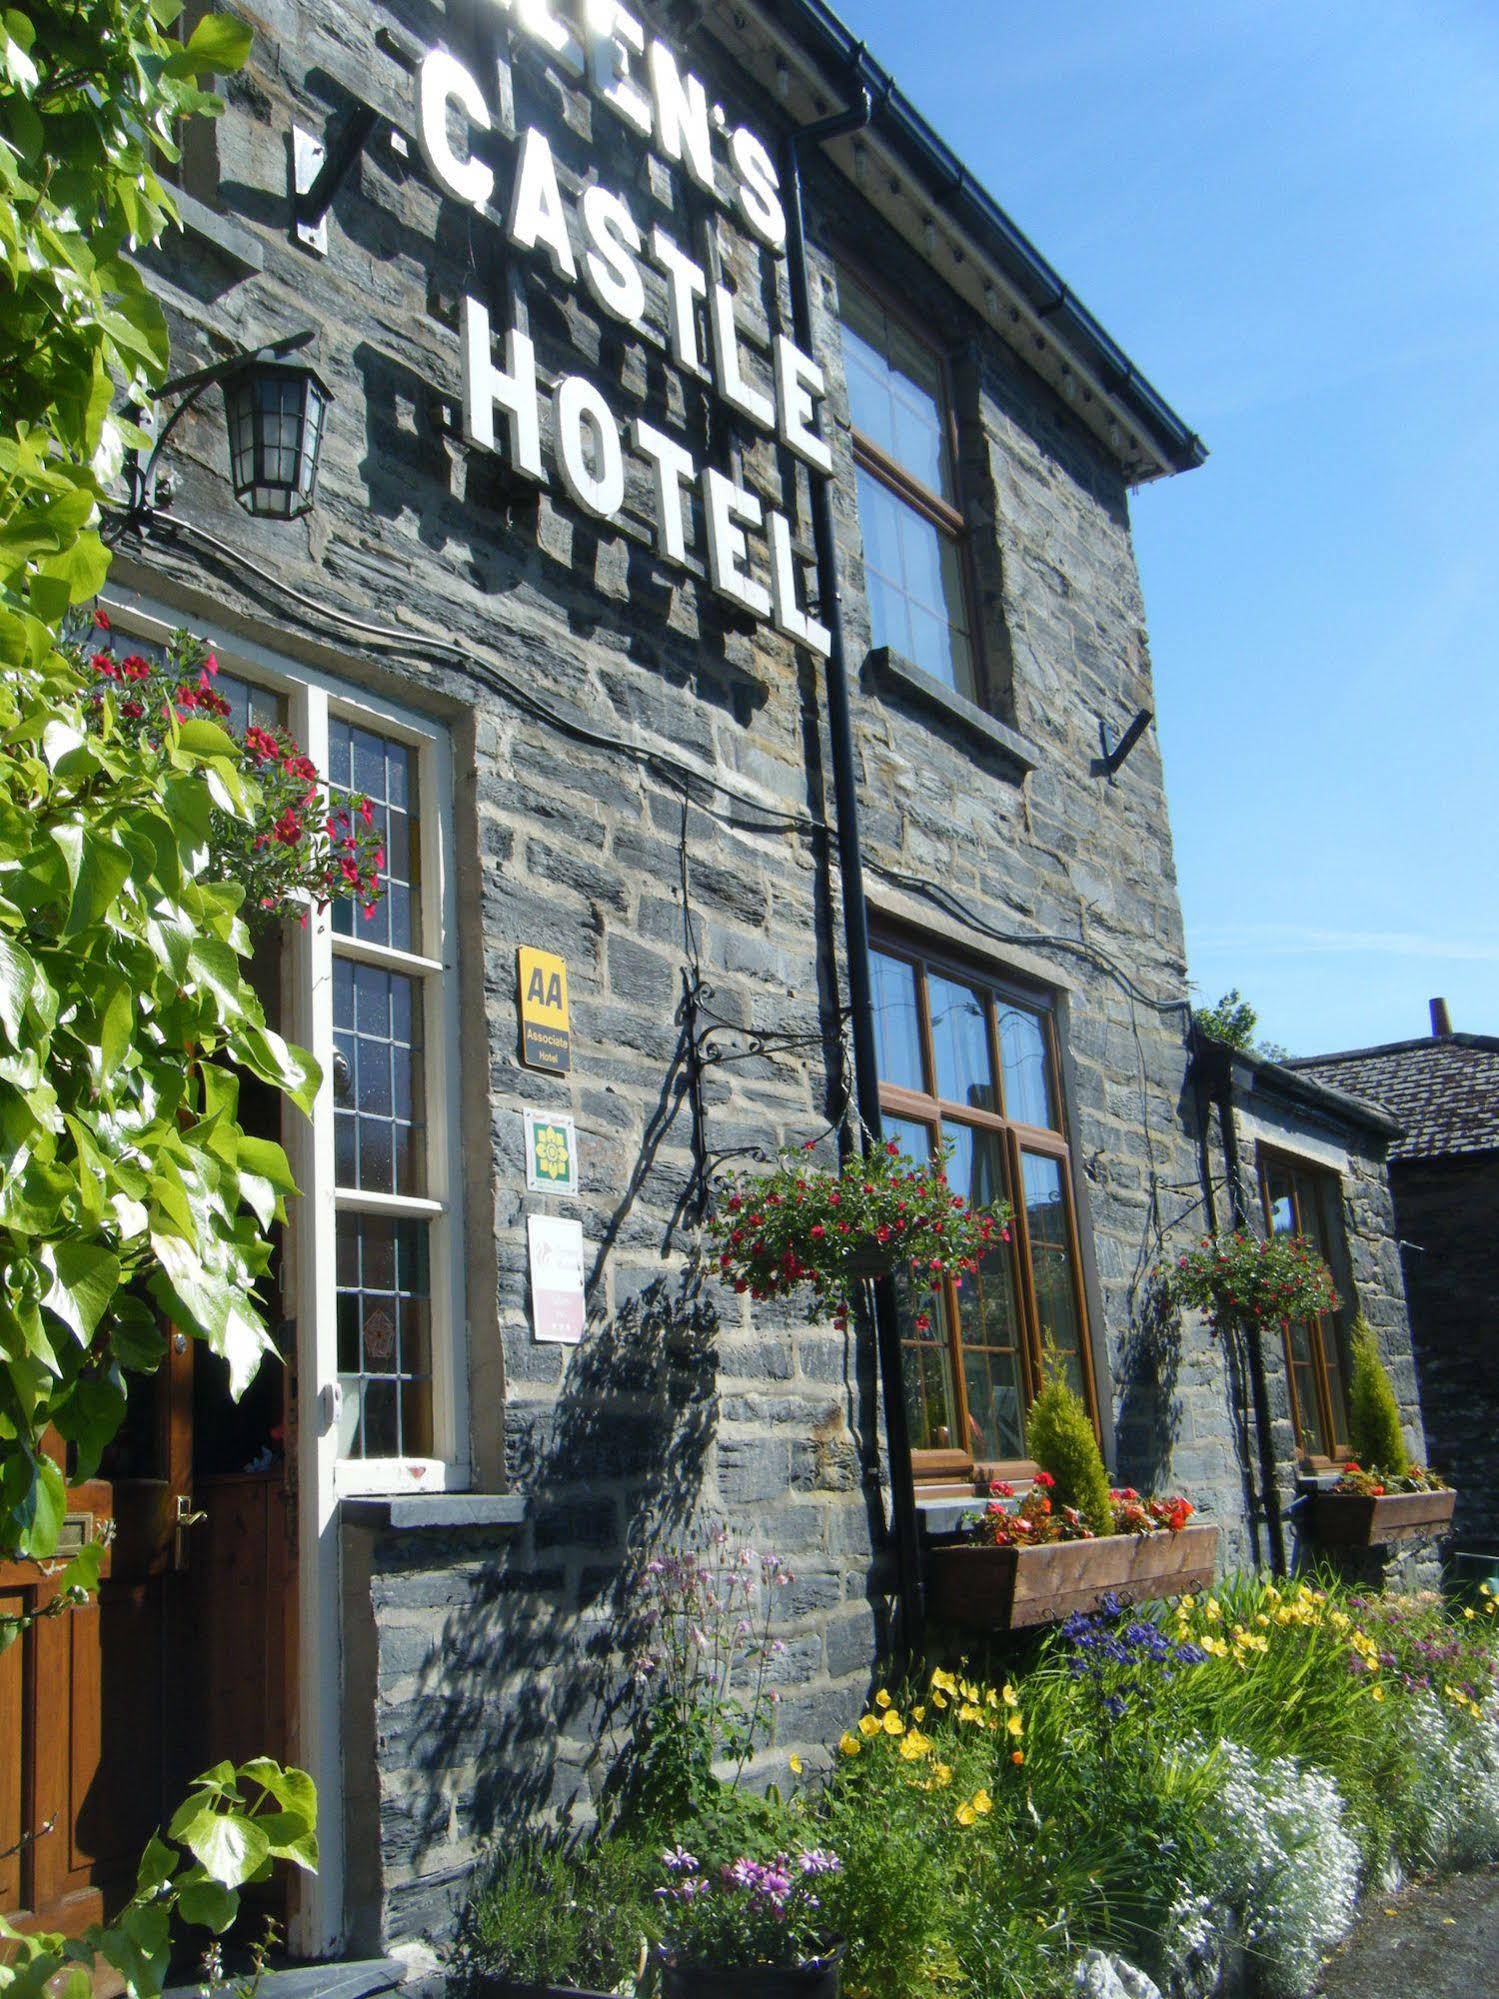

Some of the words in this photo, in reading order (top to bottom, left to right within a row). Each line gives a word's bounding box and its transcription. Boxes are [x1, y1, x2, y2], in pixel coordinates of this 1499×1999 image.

[414, 48, 835, 479] CASTLE
[460, 295, 832, 658] HOTEL
[527, 966, 563, 1011] AA
[526, 1028, 569, 1050] Associate
[539, 1050, 559, 1063] Hotel
